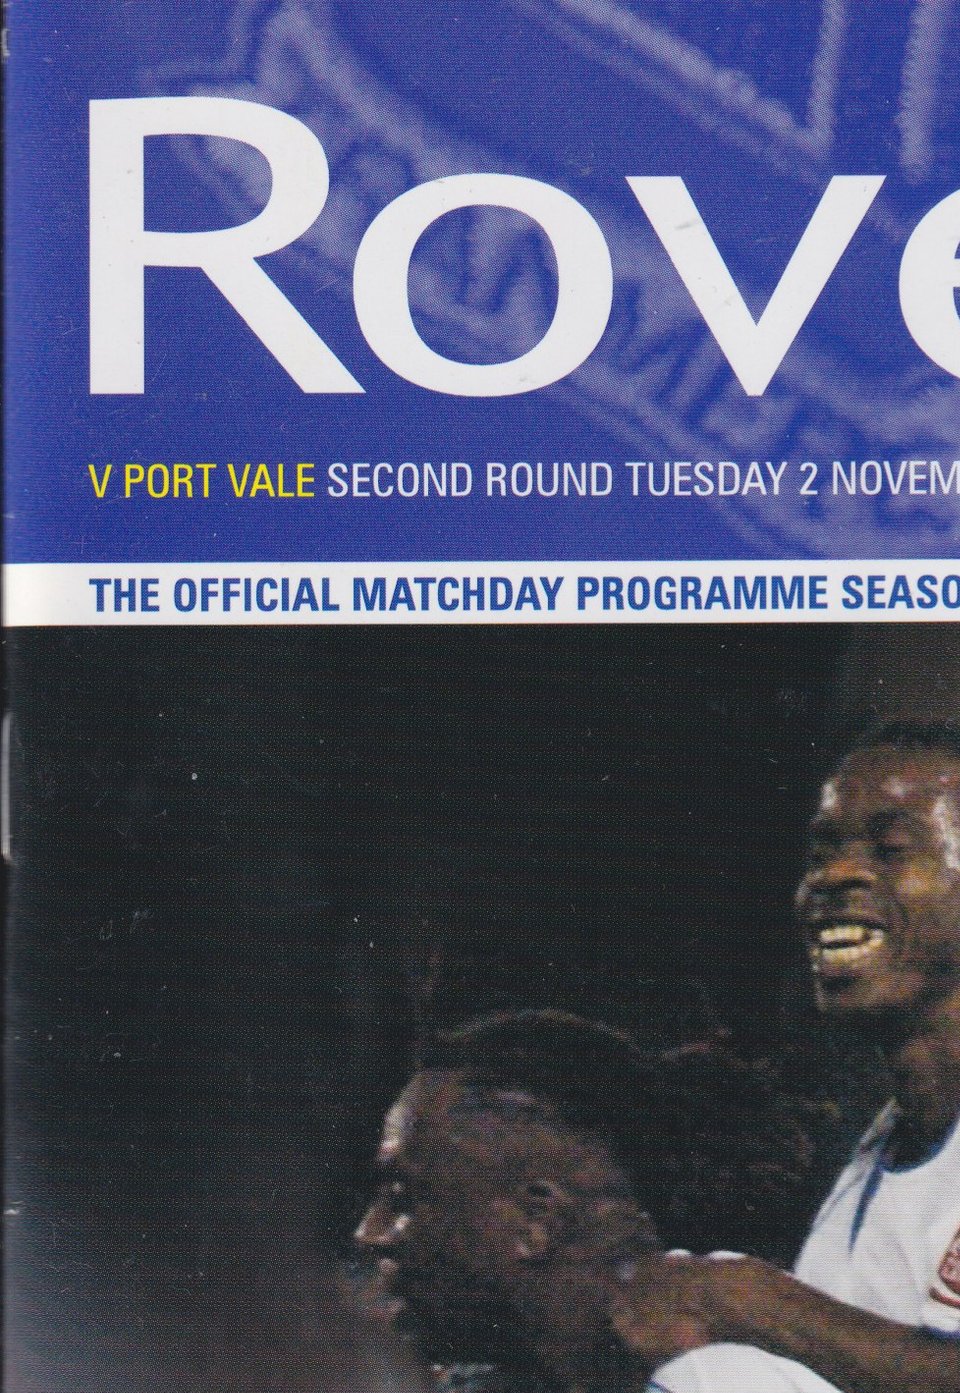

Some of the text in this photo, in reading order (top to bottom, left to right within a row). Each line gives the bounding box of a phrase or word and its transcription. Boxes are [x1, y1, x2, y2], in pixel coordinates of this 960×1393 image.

[89, 465, 113, 499] V
[125, 464, 218, 500] PORT
[228, 464, 316, 499] VALE
[328, 463, 473, 499] SECOND
[487, 463, 614, 498] ROUND
[626, 462, 789, 497] TUESDAY
[800, 463, 819, 496] 2
[89, 579, 161, 613] THE
[174, 578, 341, 614] OFFICIAL
[353, 577, 565, 613] MATCHDAY
[578, 576, 829, 612] PROGRAMME
